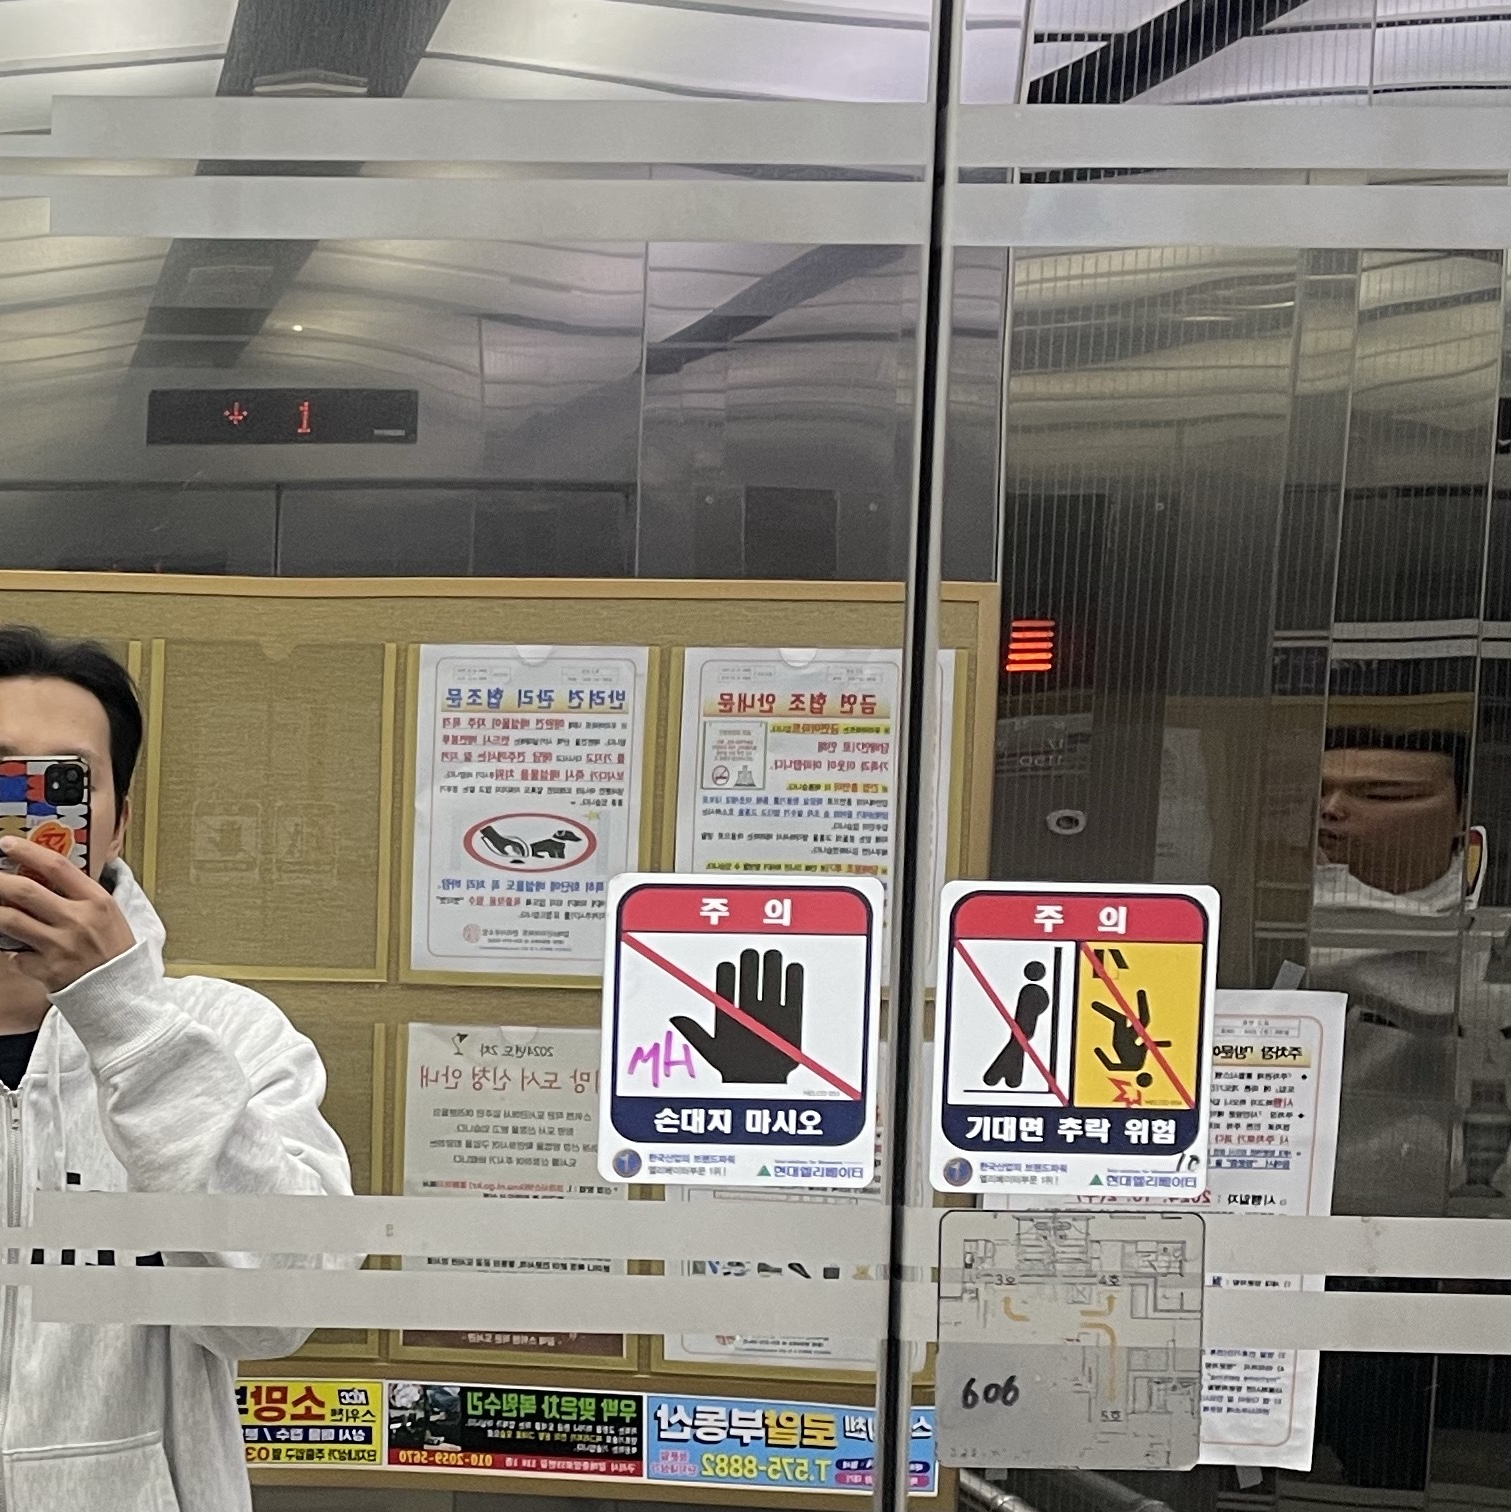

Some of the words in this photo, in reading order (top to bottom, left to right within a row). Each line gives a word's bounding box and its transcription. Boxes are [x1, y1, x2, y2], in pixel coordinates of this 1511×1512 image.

[297, 401, 311, 433] 1
[700, 897, 730, 925] 주
[763, 898, 792, 926] 의
[1034, 905, 1064, 932] 주
[1098, 906, 1126, 934] 의
[653, 1108, 732, 1134] 손대지
[745, 1109, 823, 1135] 마시오
[966, 1116, 1043, 1142] 기대면
[1058, 1117, 1110, 1144] 추락
[1124, 1117, 1176, 1145] 위험
[774, 1165, 863, 1179] 현대엘리베이터
[1107, 1175, 1197, 1188] 현대엘리베이터
[962, 1375, 1019, 1409] 606
